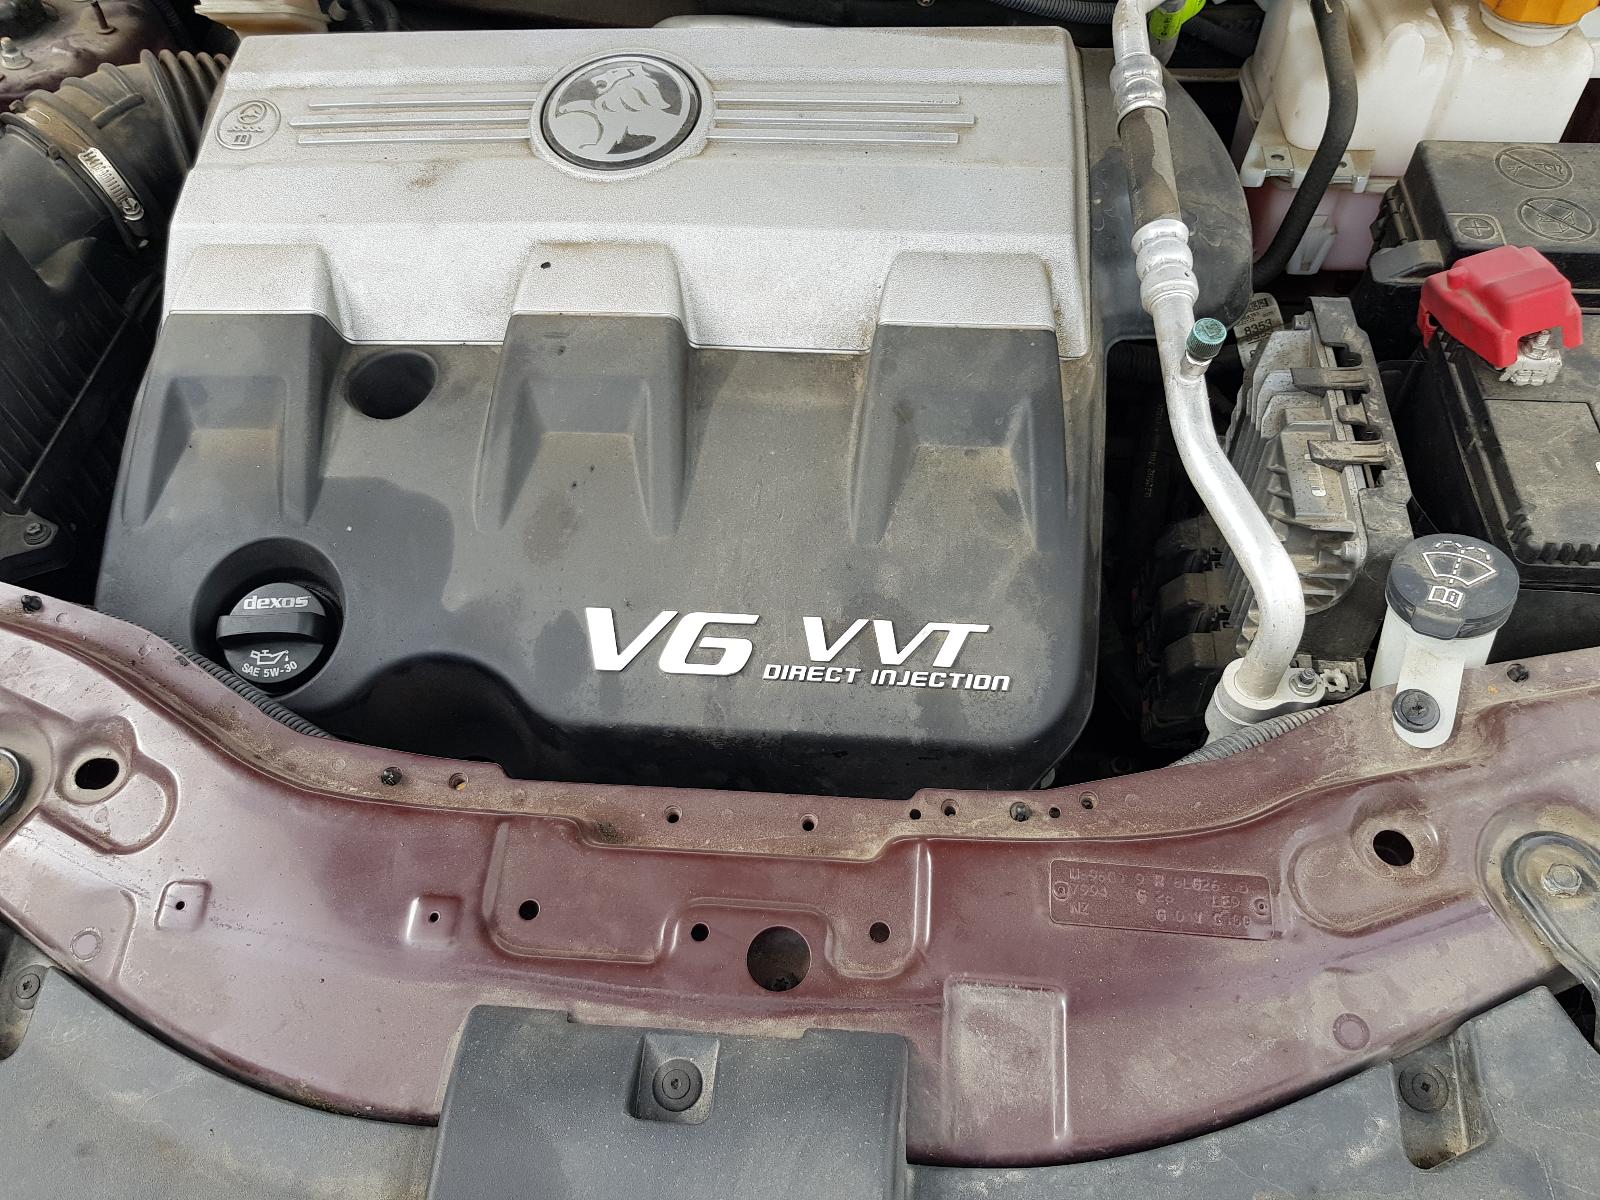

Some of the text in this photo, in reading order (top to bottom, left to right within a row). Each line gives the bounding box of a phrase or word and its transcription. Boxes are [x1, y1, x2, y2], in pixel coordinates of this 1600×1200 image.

[1244, 319, 1273, 336] 8353
[243, 595, 310, 610] dexos
[585, 606, 991, 677] V6 VVT
[241, 660, 298, 678] SAE 5W-30
[762, 663, 1011, 692] DIRECT INJECTION
